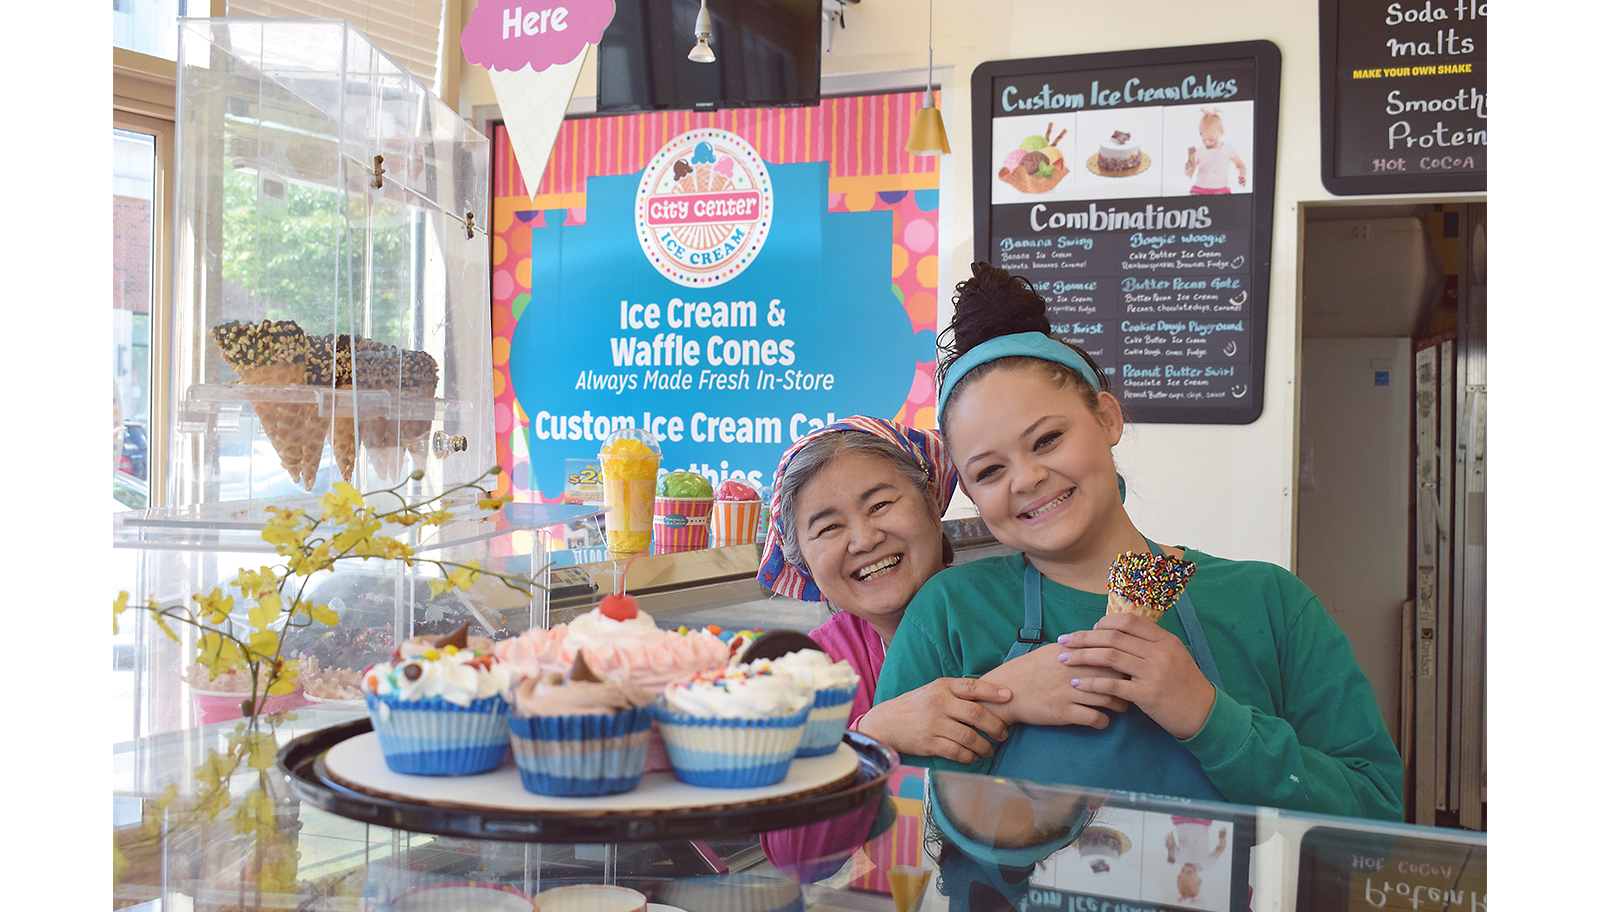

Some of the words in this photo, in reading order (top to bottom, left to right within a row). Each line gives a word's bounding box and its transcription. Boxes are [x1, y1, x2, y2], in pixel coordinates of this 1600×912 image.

[1385, 0, 1448, 25] Soda
[502, 6, 569, 40] Here
[1386, 28, 1475, 57] malts
[1353, 69, 1382, 79] MAKE
[1383, 66, 1411, 78] YOUR
[1411, 65, 1437, 76] OWN
[1437, 63, 1472, 75] SHAKE
[1001, 84, 1085, 112] Custom
[1090, 80, 1121, 106] Ice
[1123, 77, 1181, 103] Cream
[1181, 74, 1238, 99] Cakes
[1372, 158, 1406, 172] Hot
[650, 199, 690, 220] City
[693, 197, 757, 218] Center
[1030, 203, 1212, 232] Combinations
[660, 232, 686, 260] ICE
[689, 227, 746, 265] CREAM
[1000, 237, 1052, 252] Banana
[1057, 235, 1094, 250] Swing
[1130, 232, 1176, 249] Boogie
[1001, 251, 1030, 262] Banana
[1035, 251, 1046, 259] Ice
[1051, 250, 1073, 259] Cream
[1129, 251, 1147, 260] Cake
[1181, 250, 1195, 258] Ice
[1197, 249, 1222, 258] Cream
[1053, 280, 1097, 295] Bounce
[1121, 277, 1171, 293] Butter
[1172, 276, 1207, 290] Pecan
[1056, 295, 1068, 303] Ice
[1070, 295, 1093, 303] Cream
[1124, 292, 1152, 303] Butter
[1176, 293, 1190, 301] Ice
[1193, 293, 1219, 301] Cream
[620, 300, 661, 330] Ice
[667, 298, 757, 329] Cream
[767, 298, 786, 327] &
[1072, 322, 1103, 335] Twist
[1121, 320, 1157, 333] Cookie
[1157, 320, 1187, 336] Dough
[1188, 320, 1245, 336] Playground
[1123, 335, 1143, 345] Cake
[1171, 335, 1183, 344] Ice
[1185, 336, 1207, 344] Cream
[610, 333, 700, 367] Waffle
[706, 335, 796, 366] Cones
[1122, 363, 1162, 378] Peanut
[1165, 364, 1203, 378] Butter
[1204, 366, 1235, 377] Swirl
[574, 370, 638, 395] Always
[643, 370, 693, 390] Made
[698, 369, 750, 390] Fresh
[756, 369, 835, 391] In-Store
[1183, 378, 1209, 387] Cream
[535, 410, 636, 442] Custom
[643, 412, 685, 442] Ice
[690, 411, 782, 444] Cream
